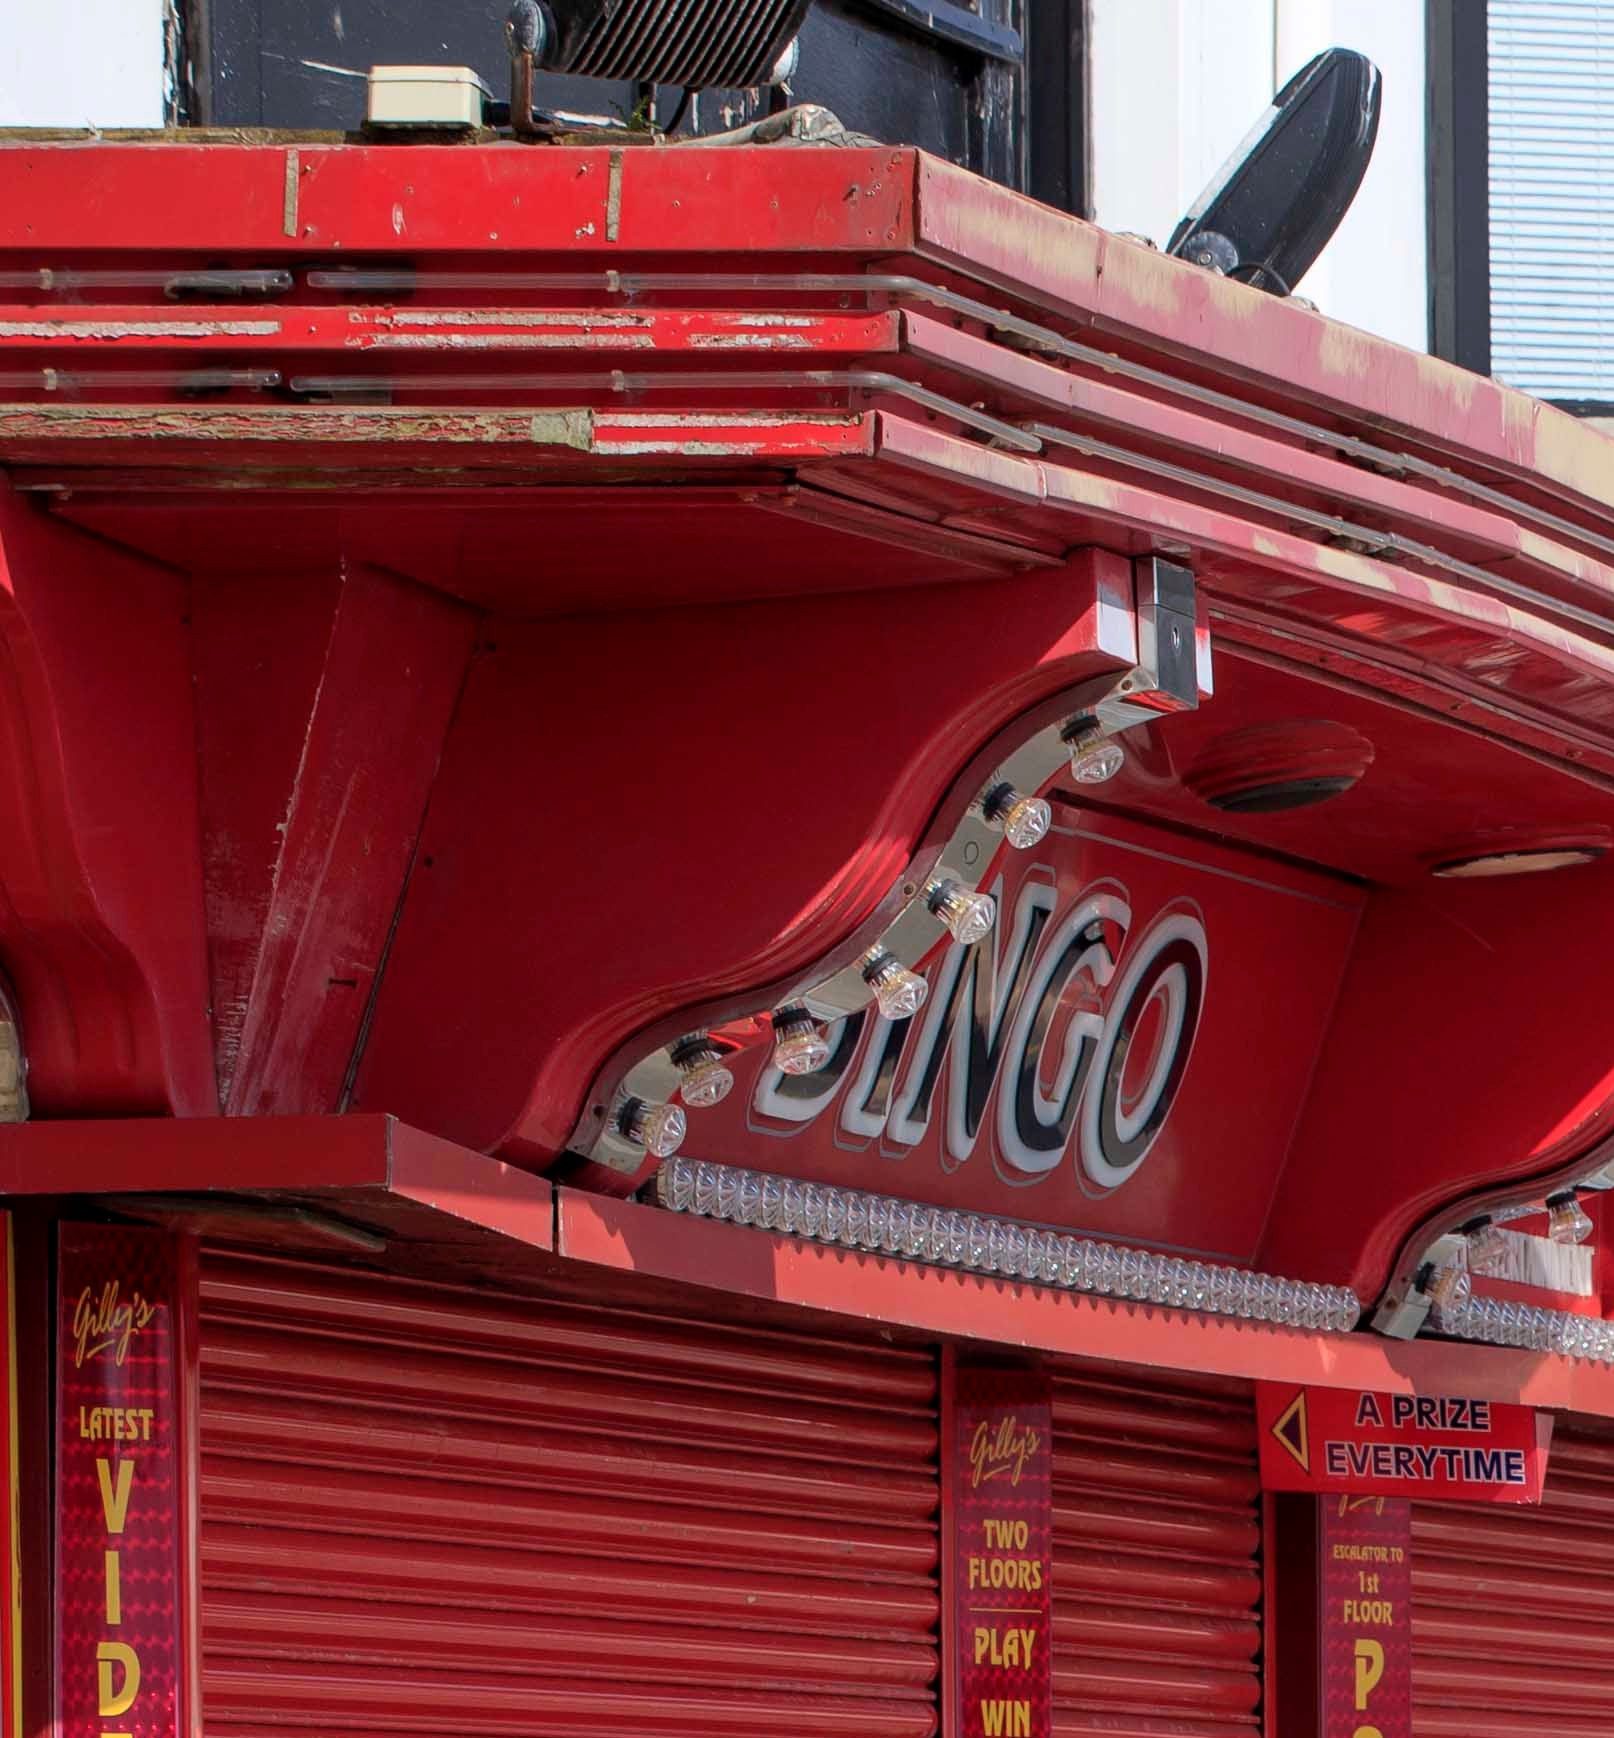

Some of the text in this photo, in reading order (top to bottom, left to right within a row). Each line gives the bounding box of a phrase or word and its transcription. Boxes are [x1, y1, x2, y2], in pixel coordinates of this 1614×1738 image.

[73, 1280, 155, 1368] Gilly's
[80, 1405, 154, 1442] LATEST
[1355, 1392, 1492, 1432] A PRIZE
[970, 1421, 1041, 1487] Gilly's
[1324, 1440, 1526, 1485] EVERYTIME
[983, 1519, 1030, 1551] TWO
[1333, 1544, 1404, 1563] ESCALATOR TO
[968, 1558, 1042, 1592] FLOORS
[1359, 1570, 1379, 1594] 1st
[1343, 1599, 1393, 1627] FLOOR
[974, 1628, 1036, 1671] PLAY
[981, 1700, 1031, 1738] WIN
